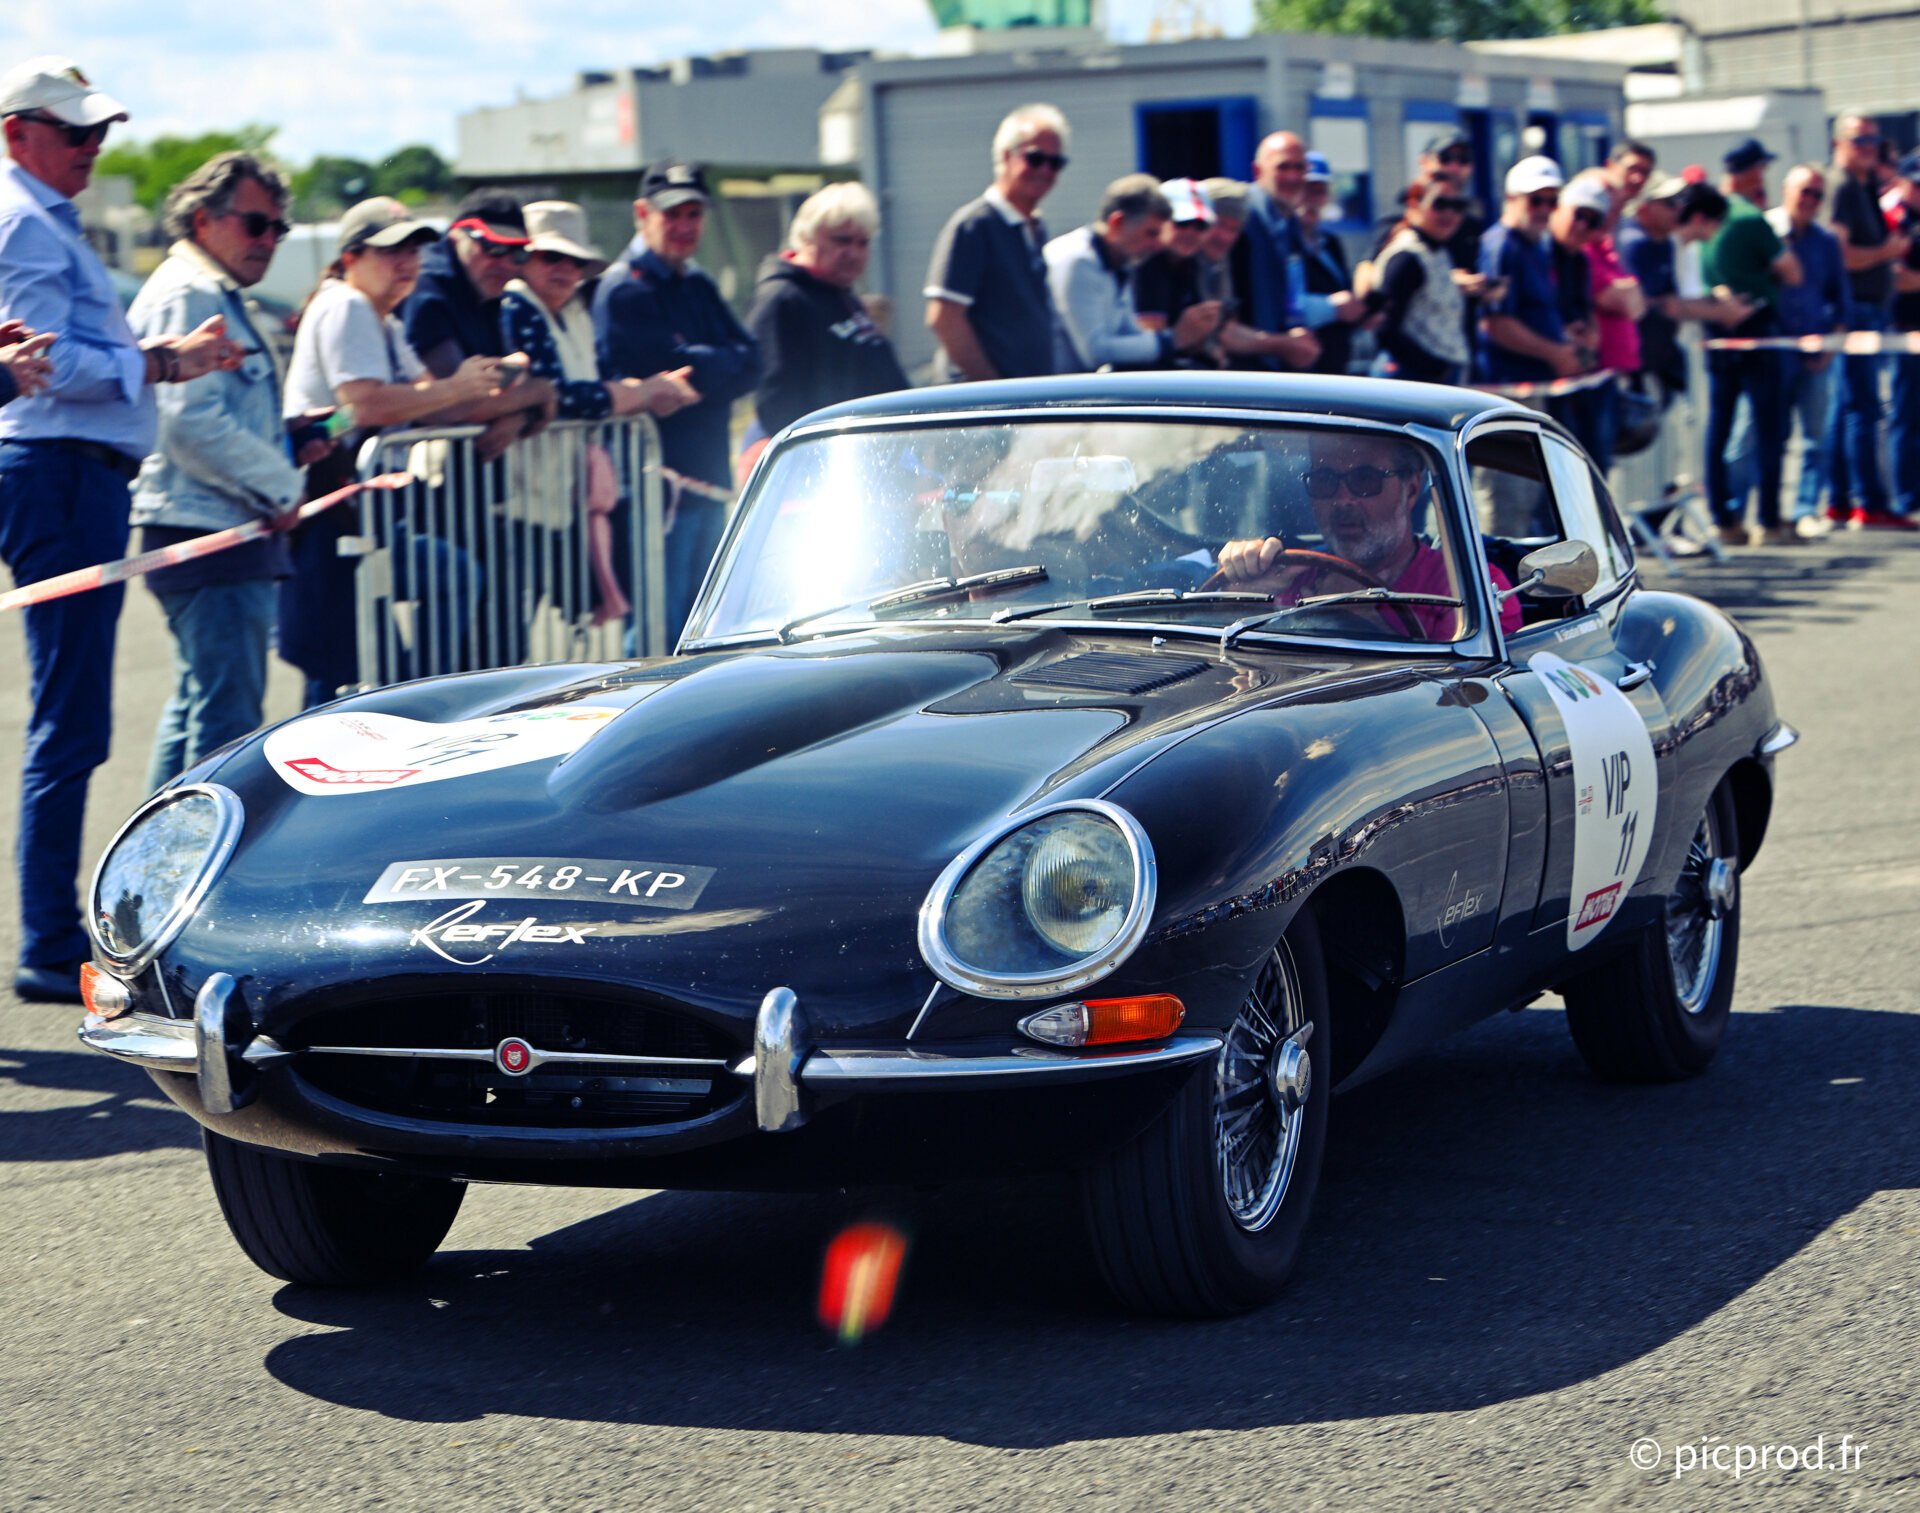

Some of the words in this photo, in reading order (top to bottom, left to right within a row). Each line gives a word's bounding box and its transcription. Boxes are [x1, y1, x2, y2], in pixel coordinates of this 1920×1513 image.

[405, 748, 497, 766] 11
[408, 733, 519, 751] VIP
[1602, 751, 1631, 819] VIP
[1615, 810, 1638, 876] 11
[391, 865, 686, 897] FX-548-KP
